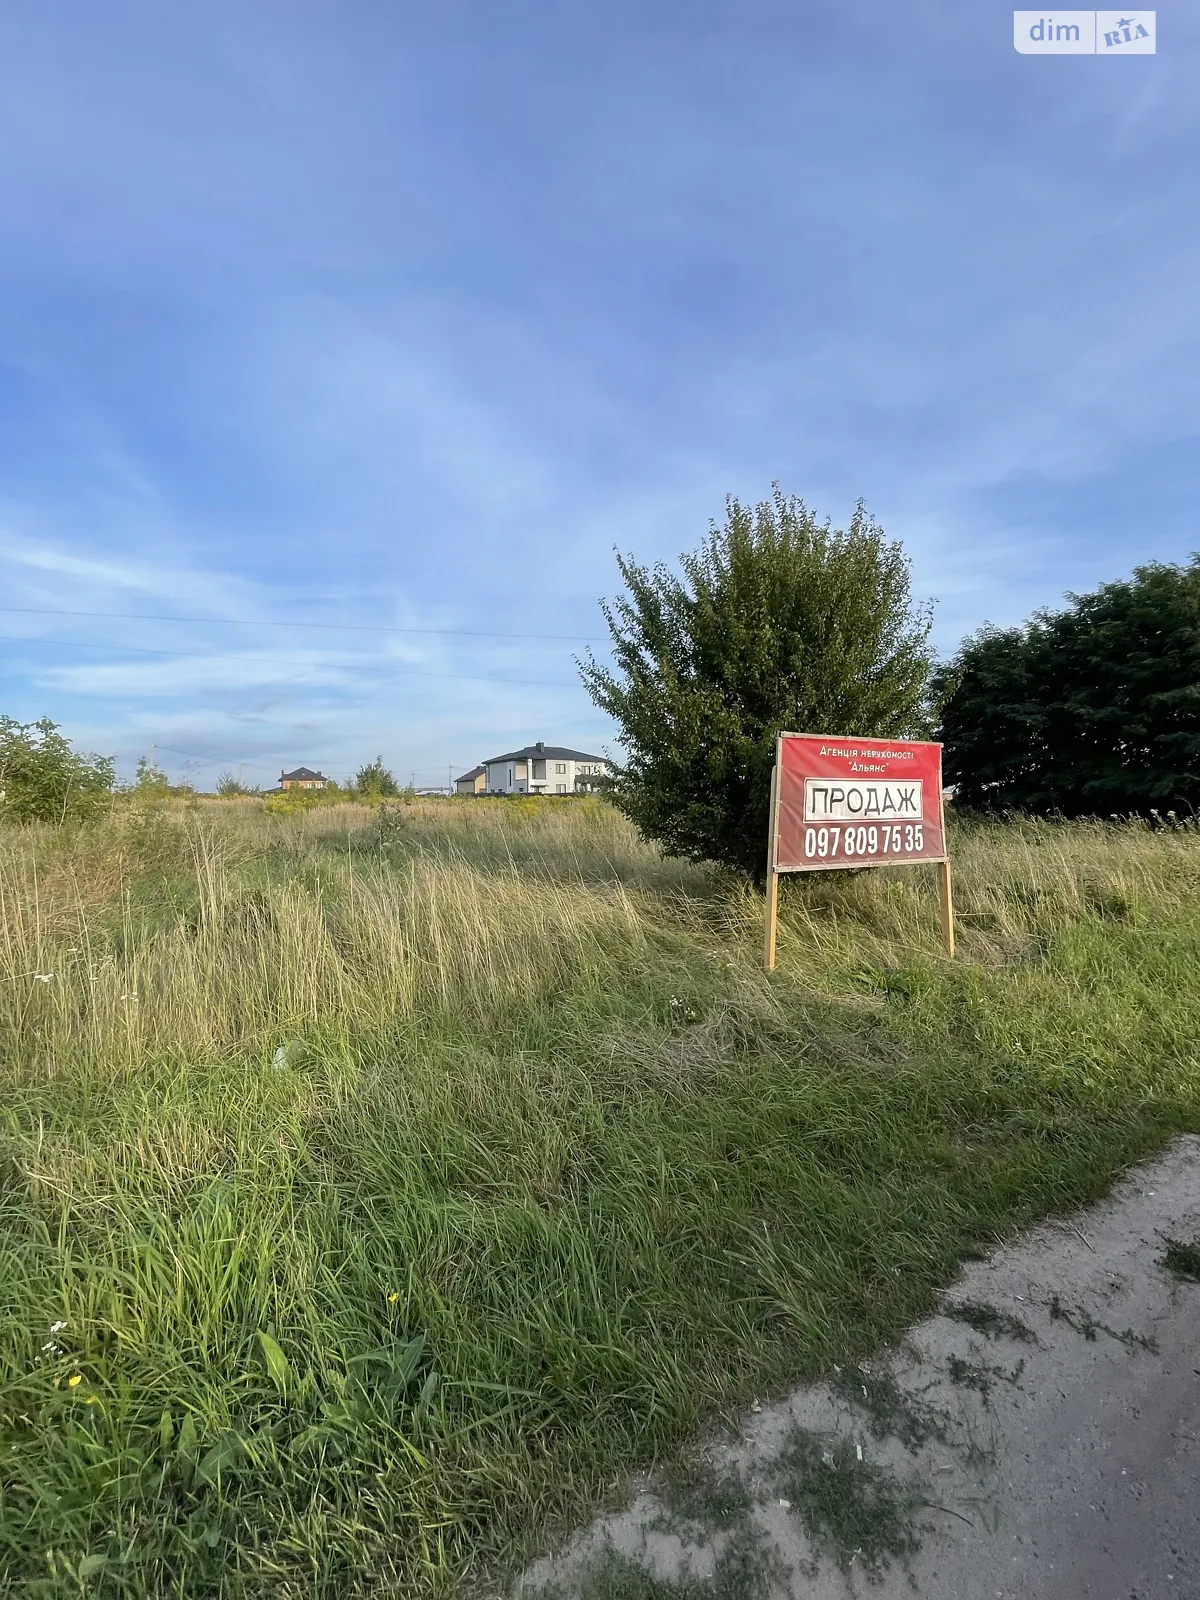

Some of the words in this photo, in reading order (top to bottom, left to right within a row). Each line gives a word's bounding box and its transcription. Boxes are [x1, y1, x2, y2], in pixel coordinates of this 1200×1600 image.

[811, 787, 917, 816] ПРОДАЖ
[804, 827, 841, 858] 097
[844, 825, 878, 855] 809
[881, 825, 902, 853] 75
[905, 824, 924, 852] 35
